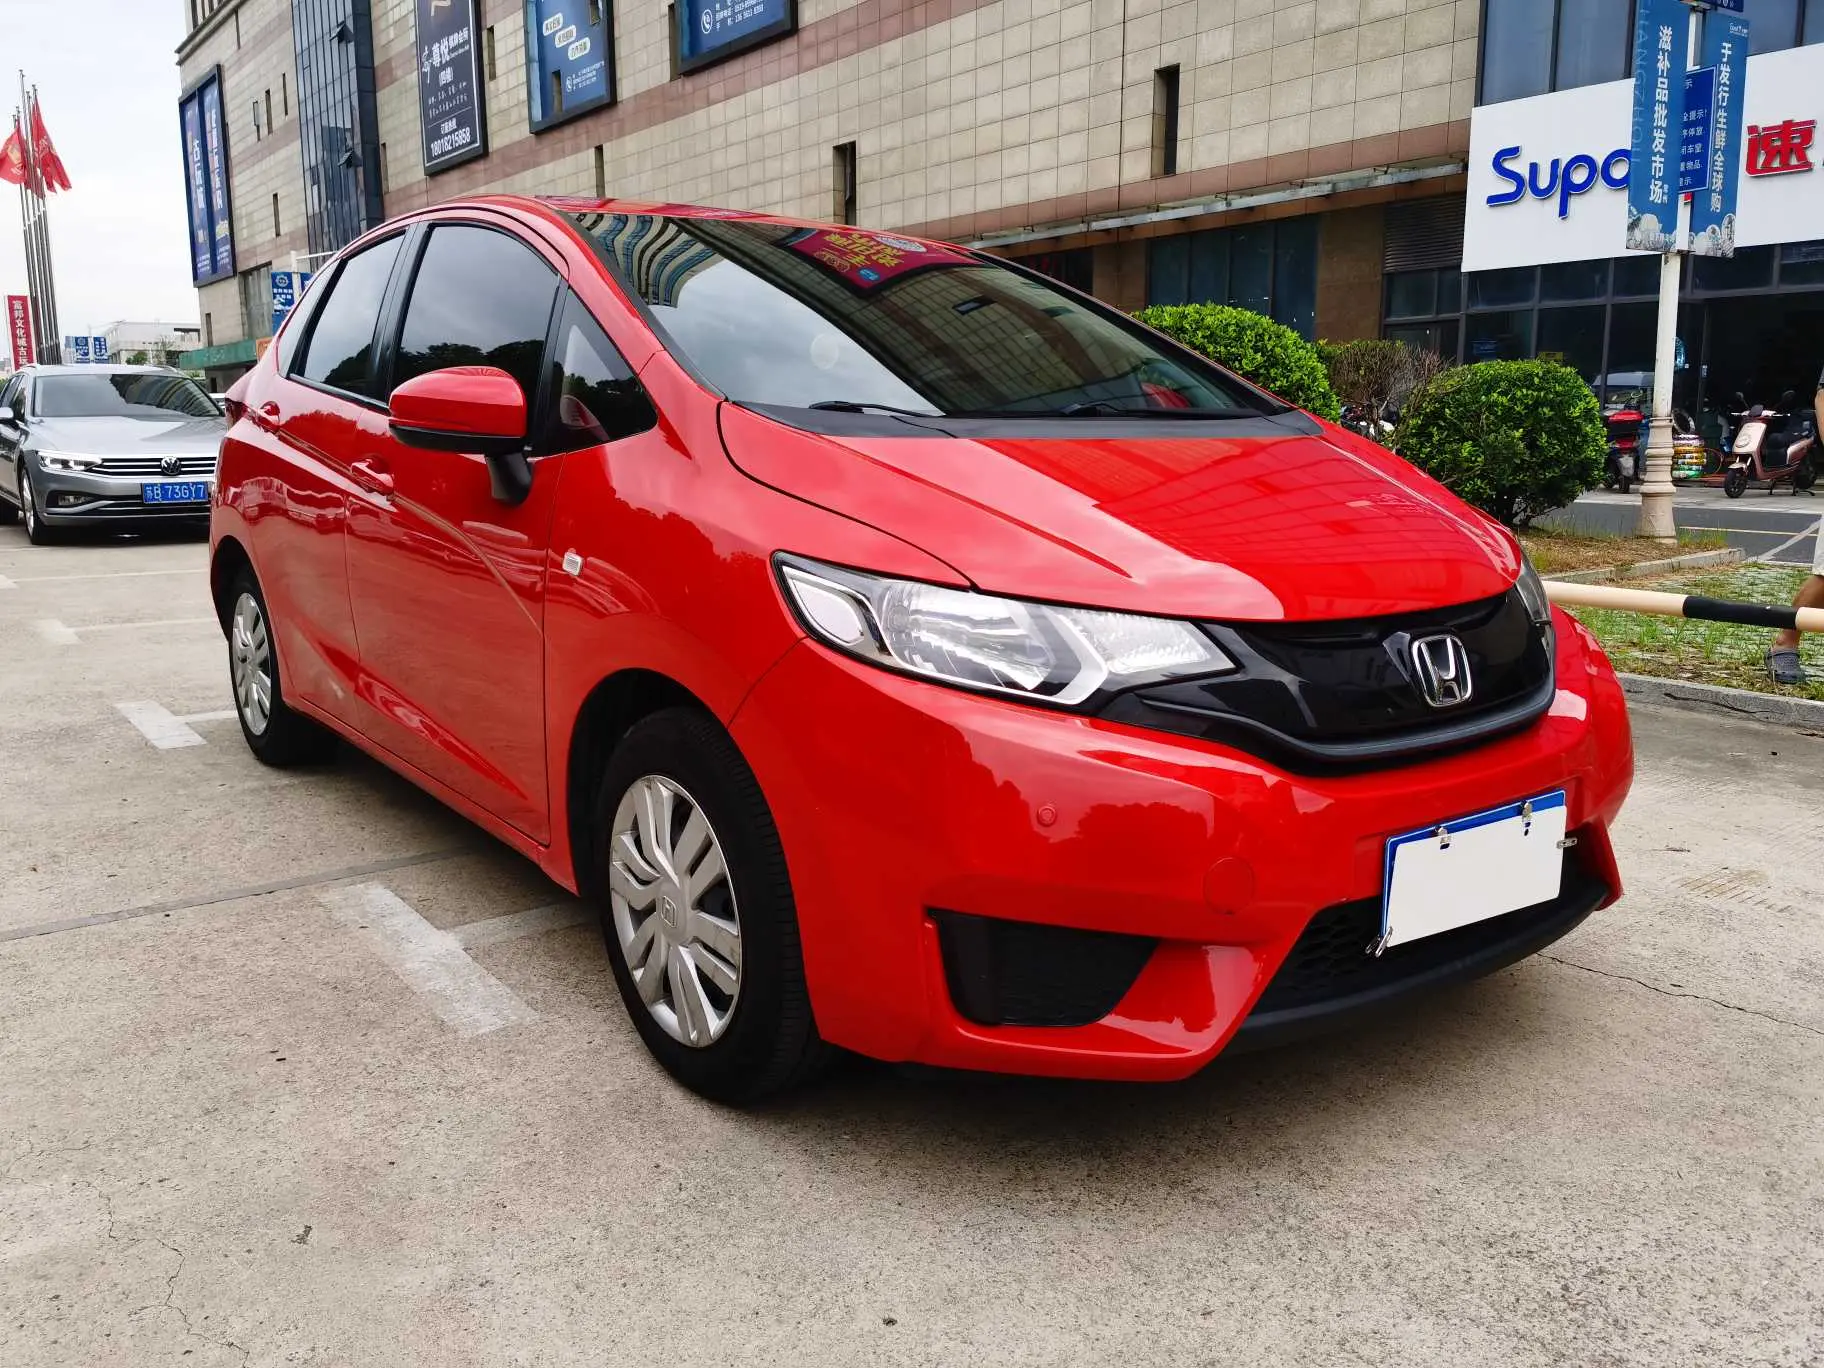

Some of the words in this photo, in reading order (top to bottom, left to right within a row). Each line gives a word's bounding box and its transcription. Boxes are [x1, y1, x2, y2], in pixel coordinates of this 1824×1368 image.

[430, 126, 472, 157] 18018215858
[1650, 25, 1673, 204] 滋补品批发市场
[1745, 119, 1817, 178] 速
